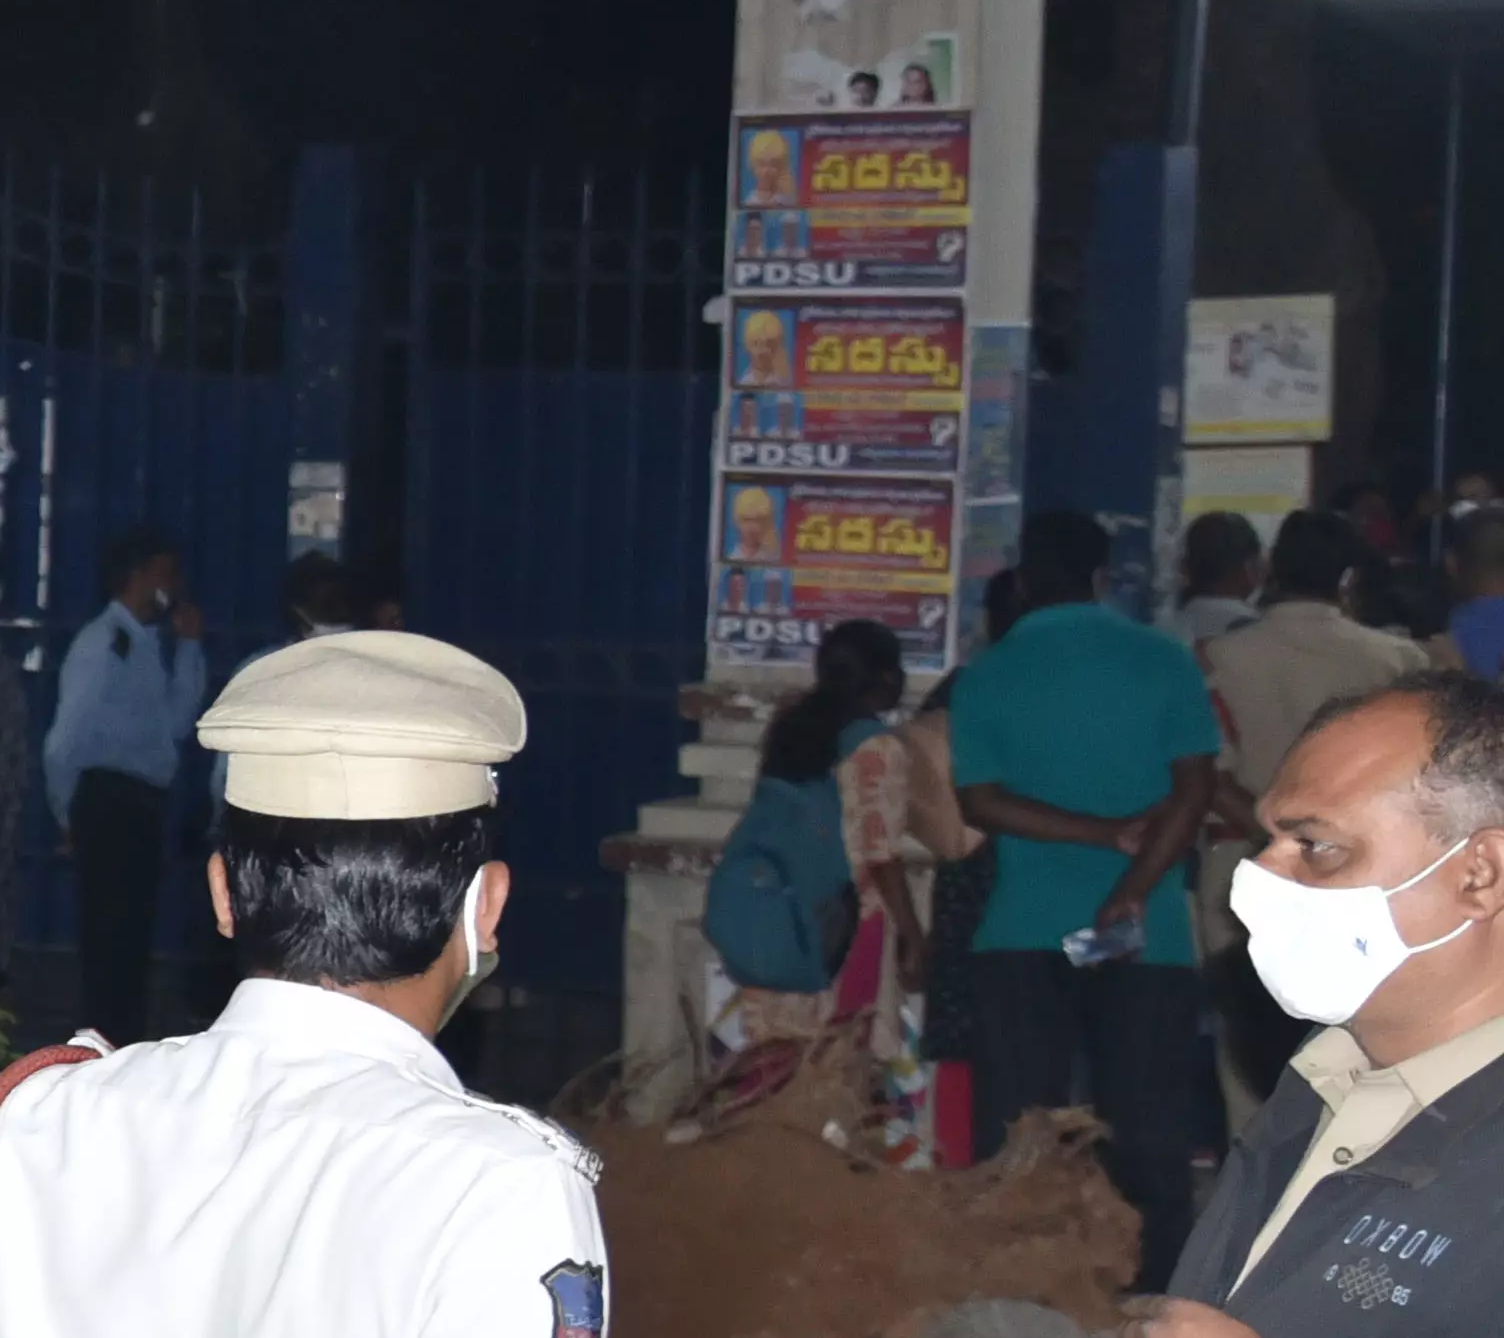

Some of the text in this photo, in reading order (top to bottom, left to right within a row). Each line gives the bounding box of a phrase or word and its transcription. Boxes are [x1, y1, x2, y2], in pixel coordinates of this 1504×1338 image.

[736, 262, 858, 286] PDSU
[730, 443, 851, 467] PDSU
[1343, 1214, 1453, 1268] OXBOW
[1390, 1285, 1413, 1307] 85
